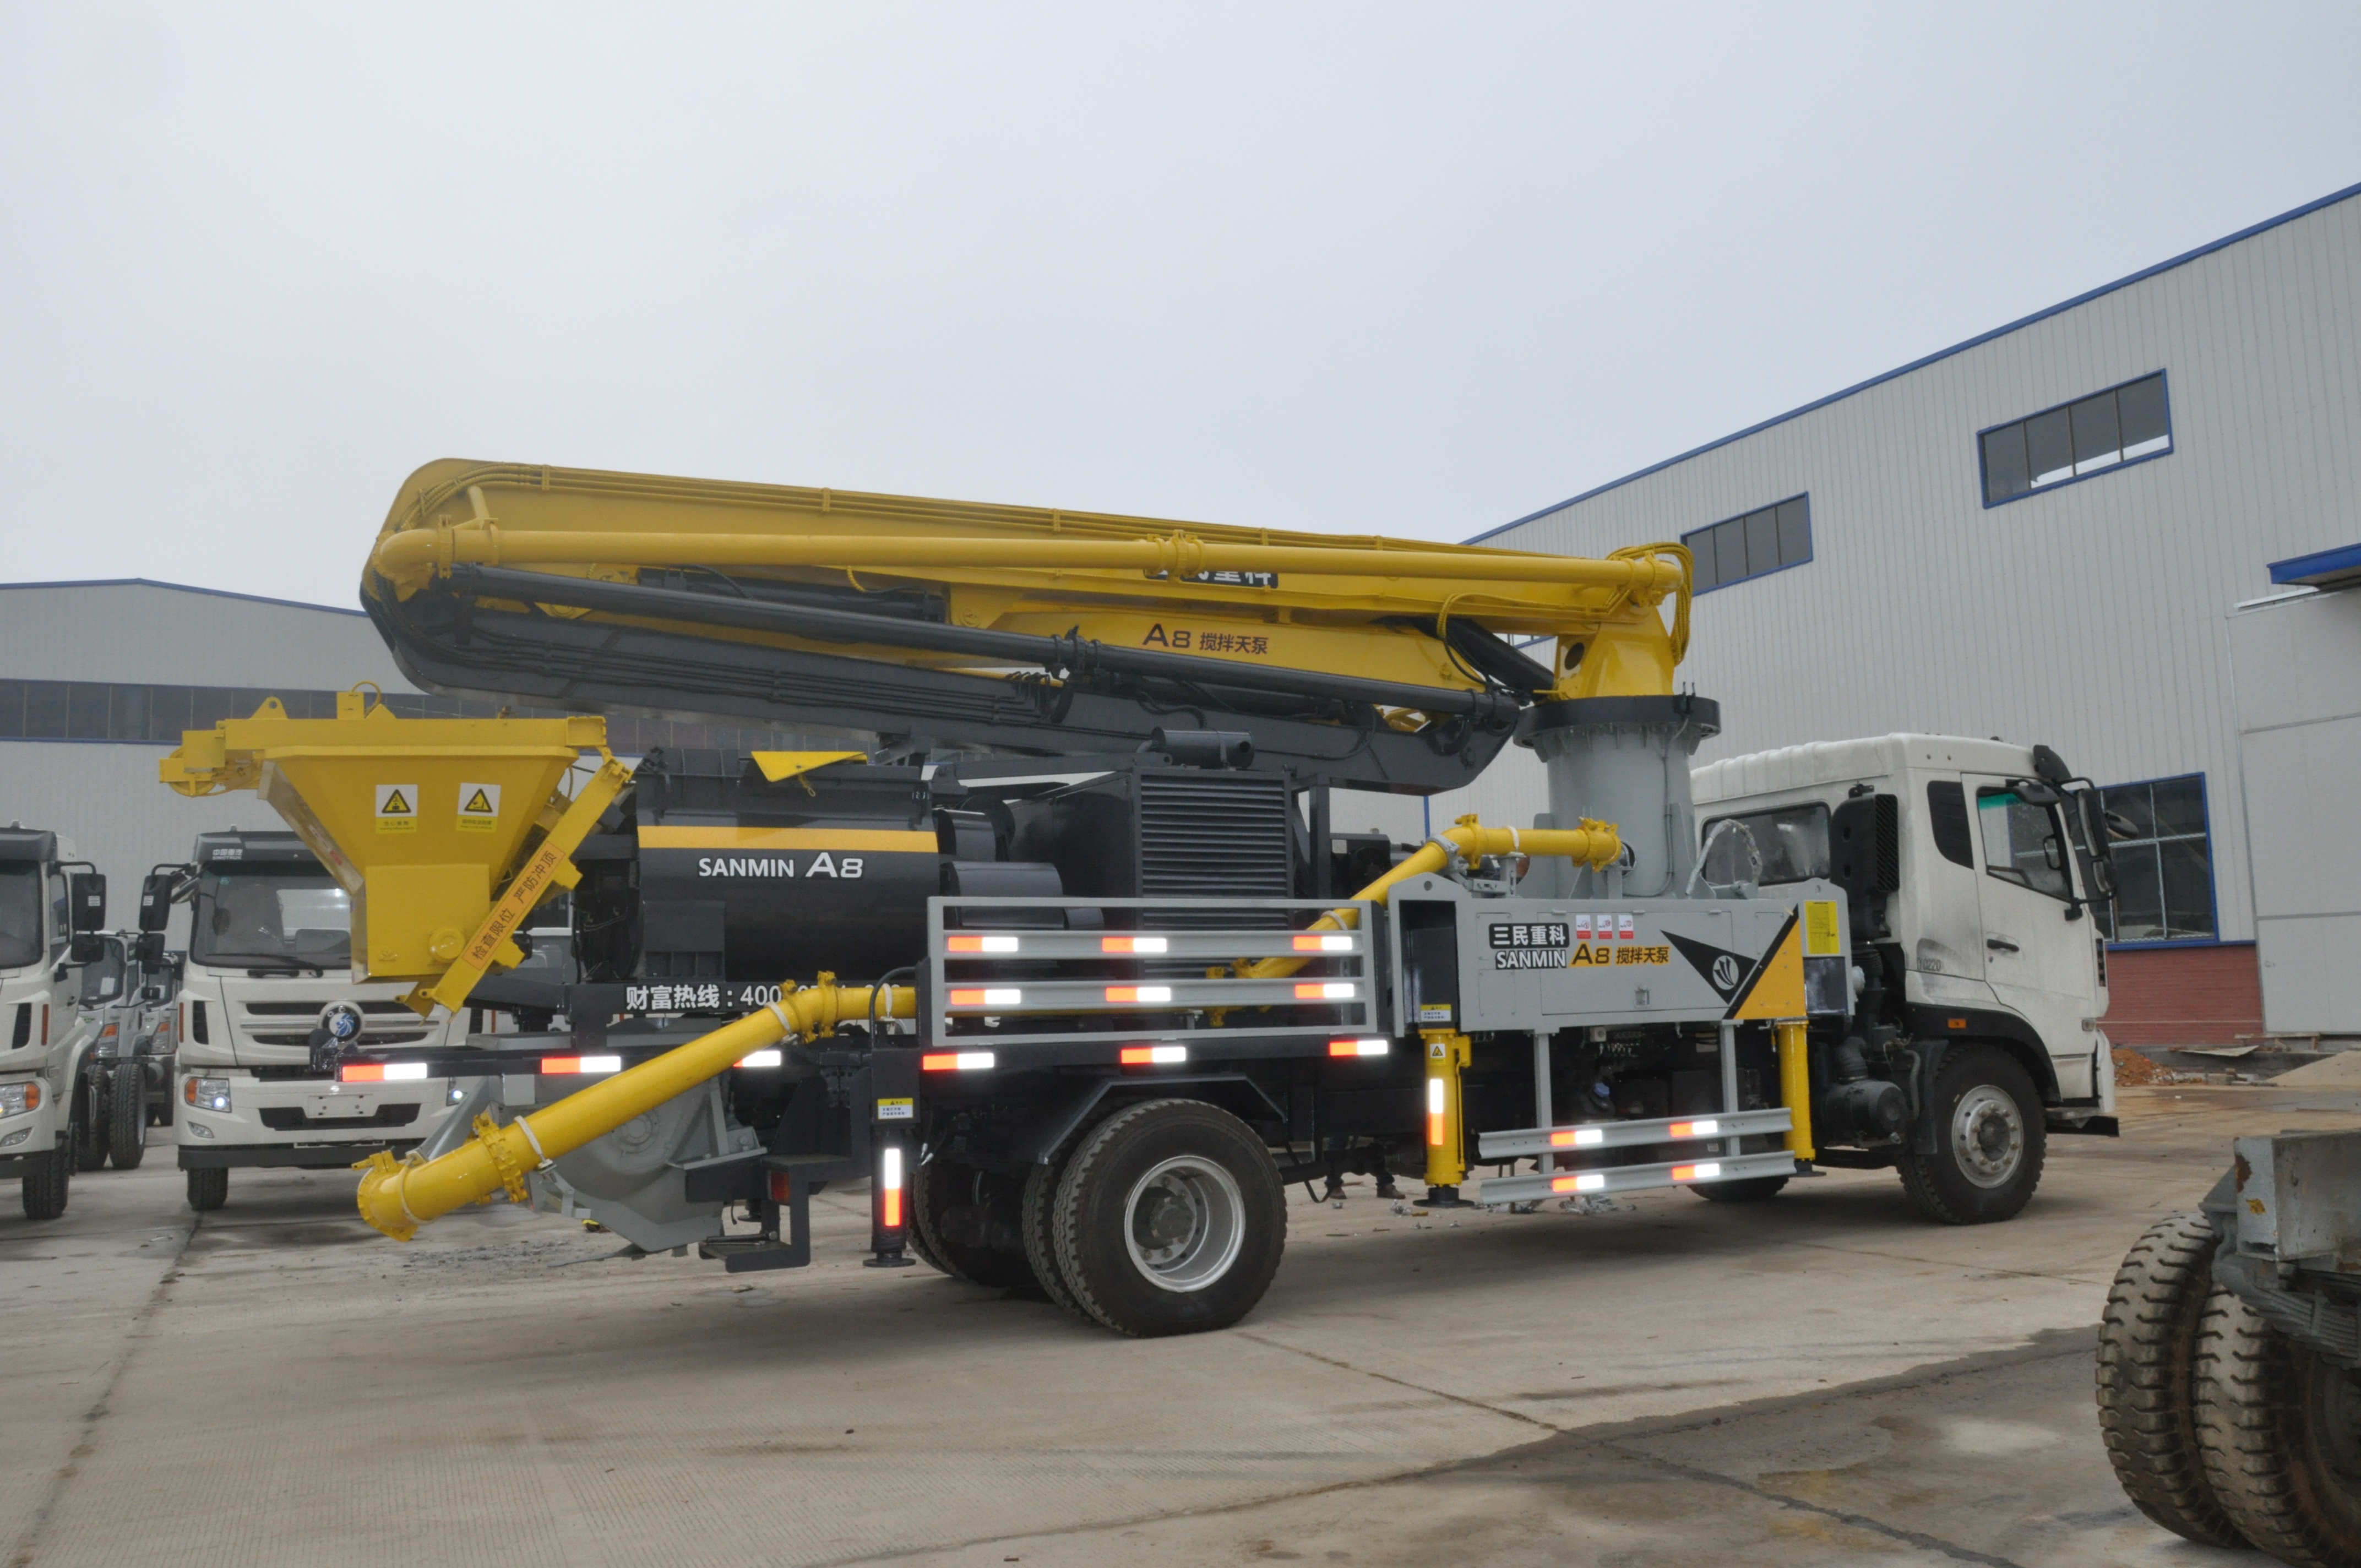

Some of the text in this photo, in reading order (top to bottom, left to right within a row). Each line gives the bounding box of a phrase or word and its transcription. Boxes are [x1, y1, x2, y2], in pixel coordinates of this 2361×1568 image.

[1142, 623, 1269, 654] A8 搅拌天泵
[698, 852, 864, 879] SANMIN A8
[471, 850, 558, 960] 检查限位 严防冲顶
[1493, 925, 1566, 946] 三民重科
[1496, 950, 1566, 969] SANMIN
[1571, 943, 1669, 965] A8 搅拌天泵
